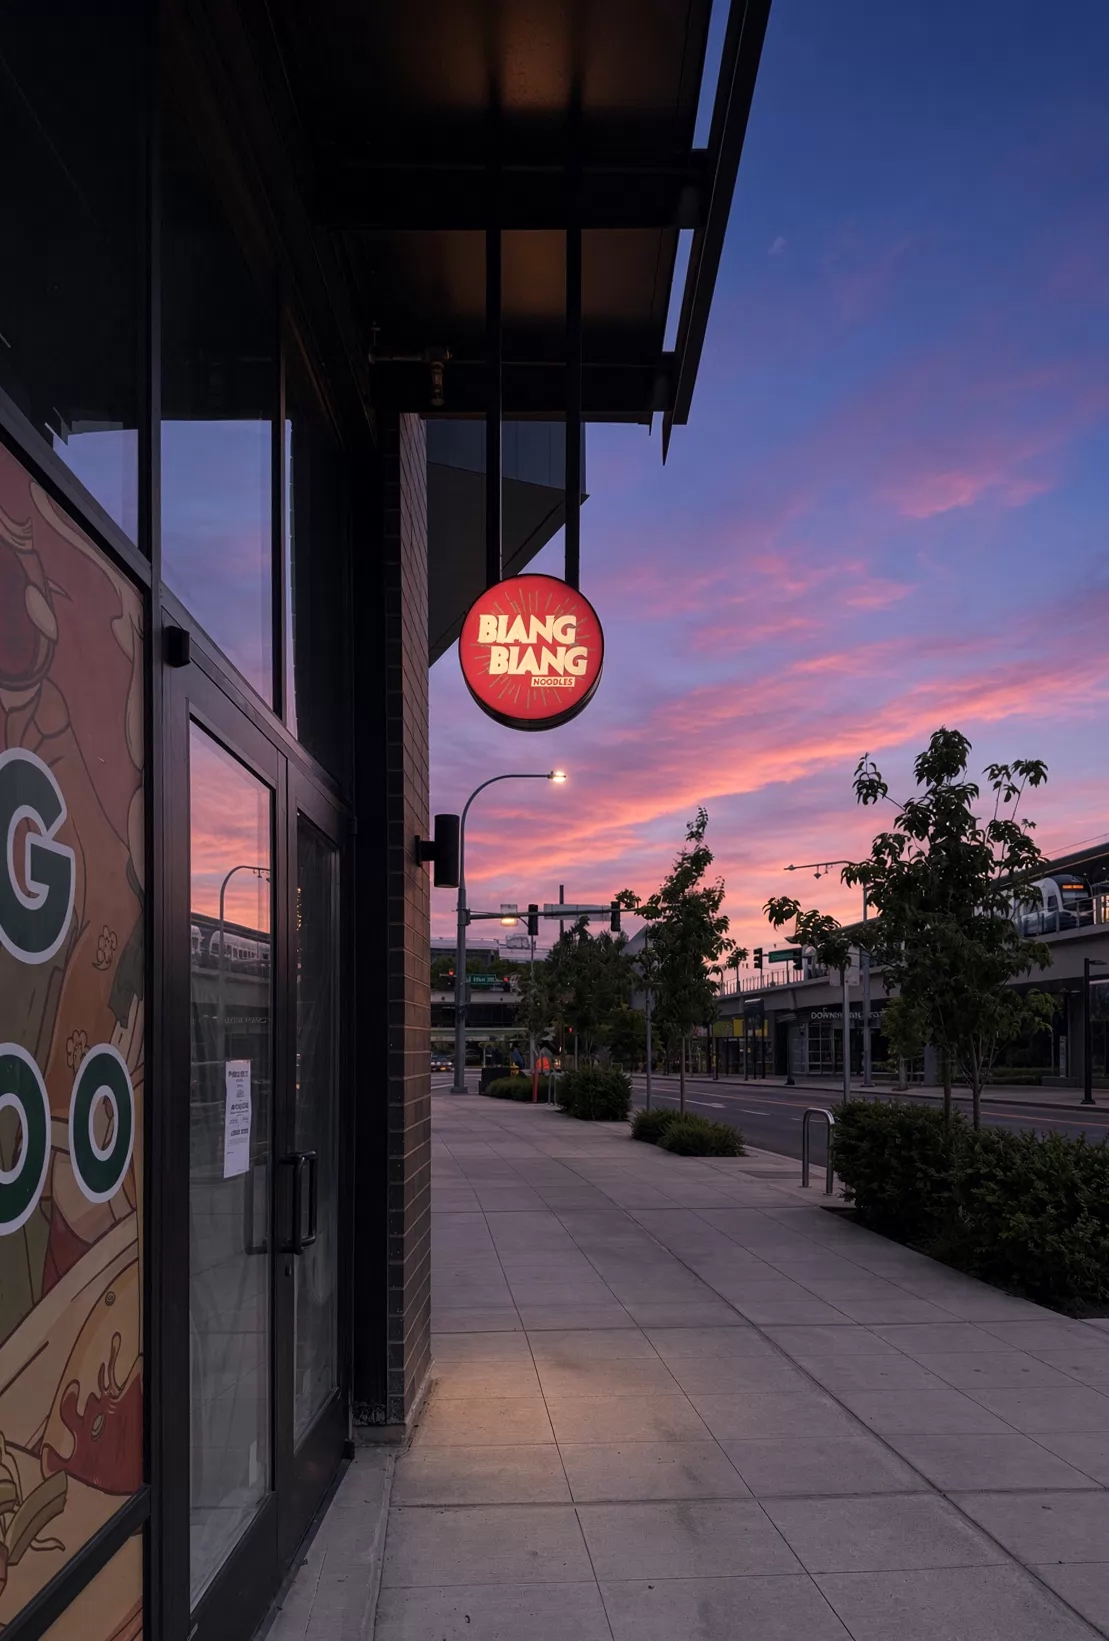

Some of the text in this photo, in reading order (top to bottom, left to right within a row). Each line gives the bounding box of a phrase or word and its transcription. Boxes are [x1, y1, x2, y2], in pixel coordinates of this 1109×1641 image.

[477, 614, 577, 645] BIANG
[488, 645, 588, 676] BIANG
[532, 677, 574, 687] NOODLES
